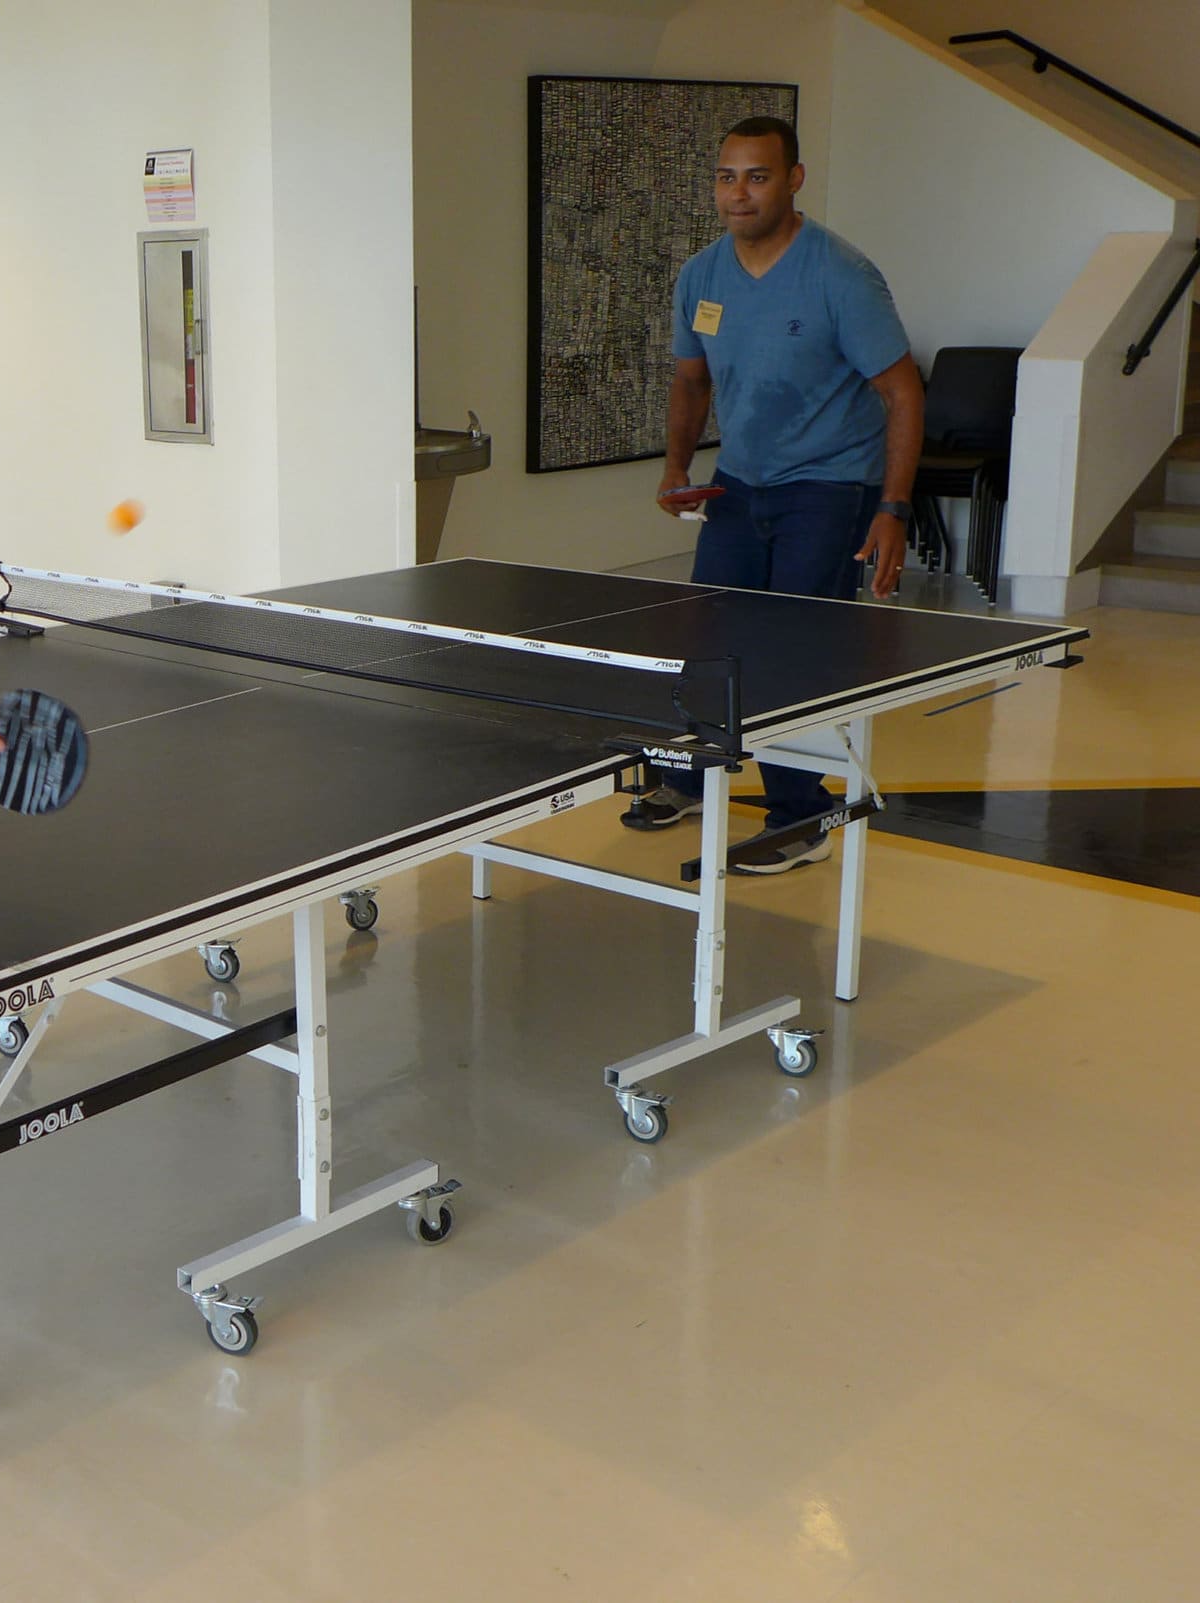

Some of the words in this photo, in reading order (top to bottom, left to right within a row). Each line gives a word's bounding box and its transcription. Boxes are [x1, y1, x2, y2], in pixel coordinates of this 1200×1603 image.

[408, 623, 428, 631] STIGA
[464, 631, 485, 640] STIGA
[523, 641, 546, 649] STIGA
[587, 650, 610, 660] STIGA
[654, 660, 682, 669] STIGA
[1015, 650, 1044, 671] JOOLA
[658, 748, 693, 763] Butterfly
[560, 791, 575, 802] USA
[820, 809, 851, 832] JOOLA
[19, 1101, 85, 1145] JOOLA
